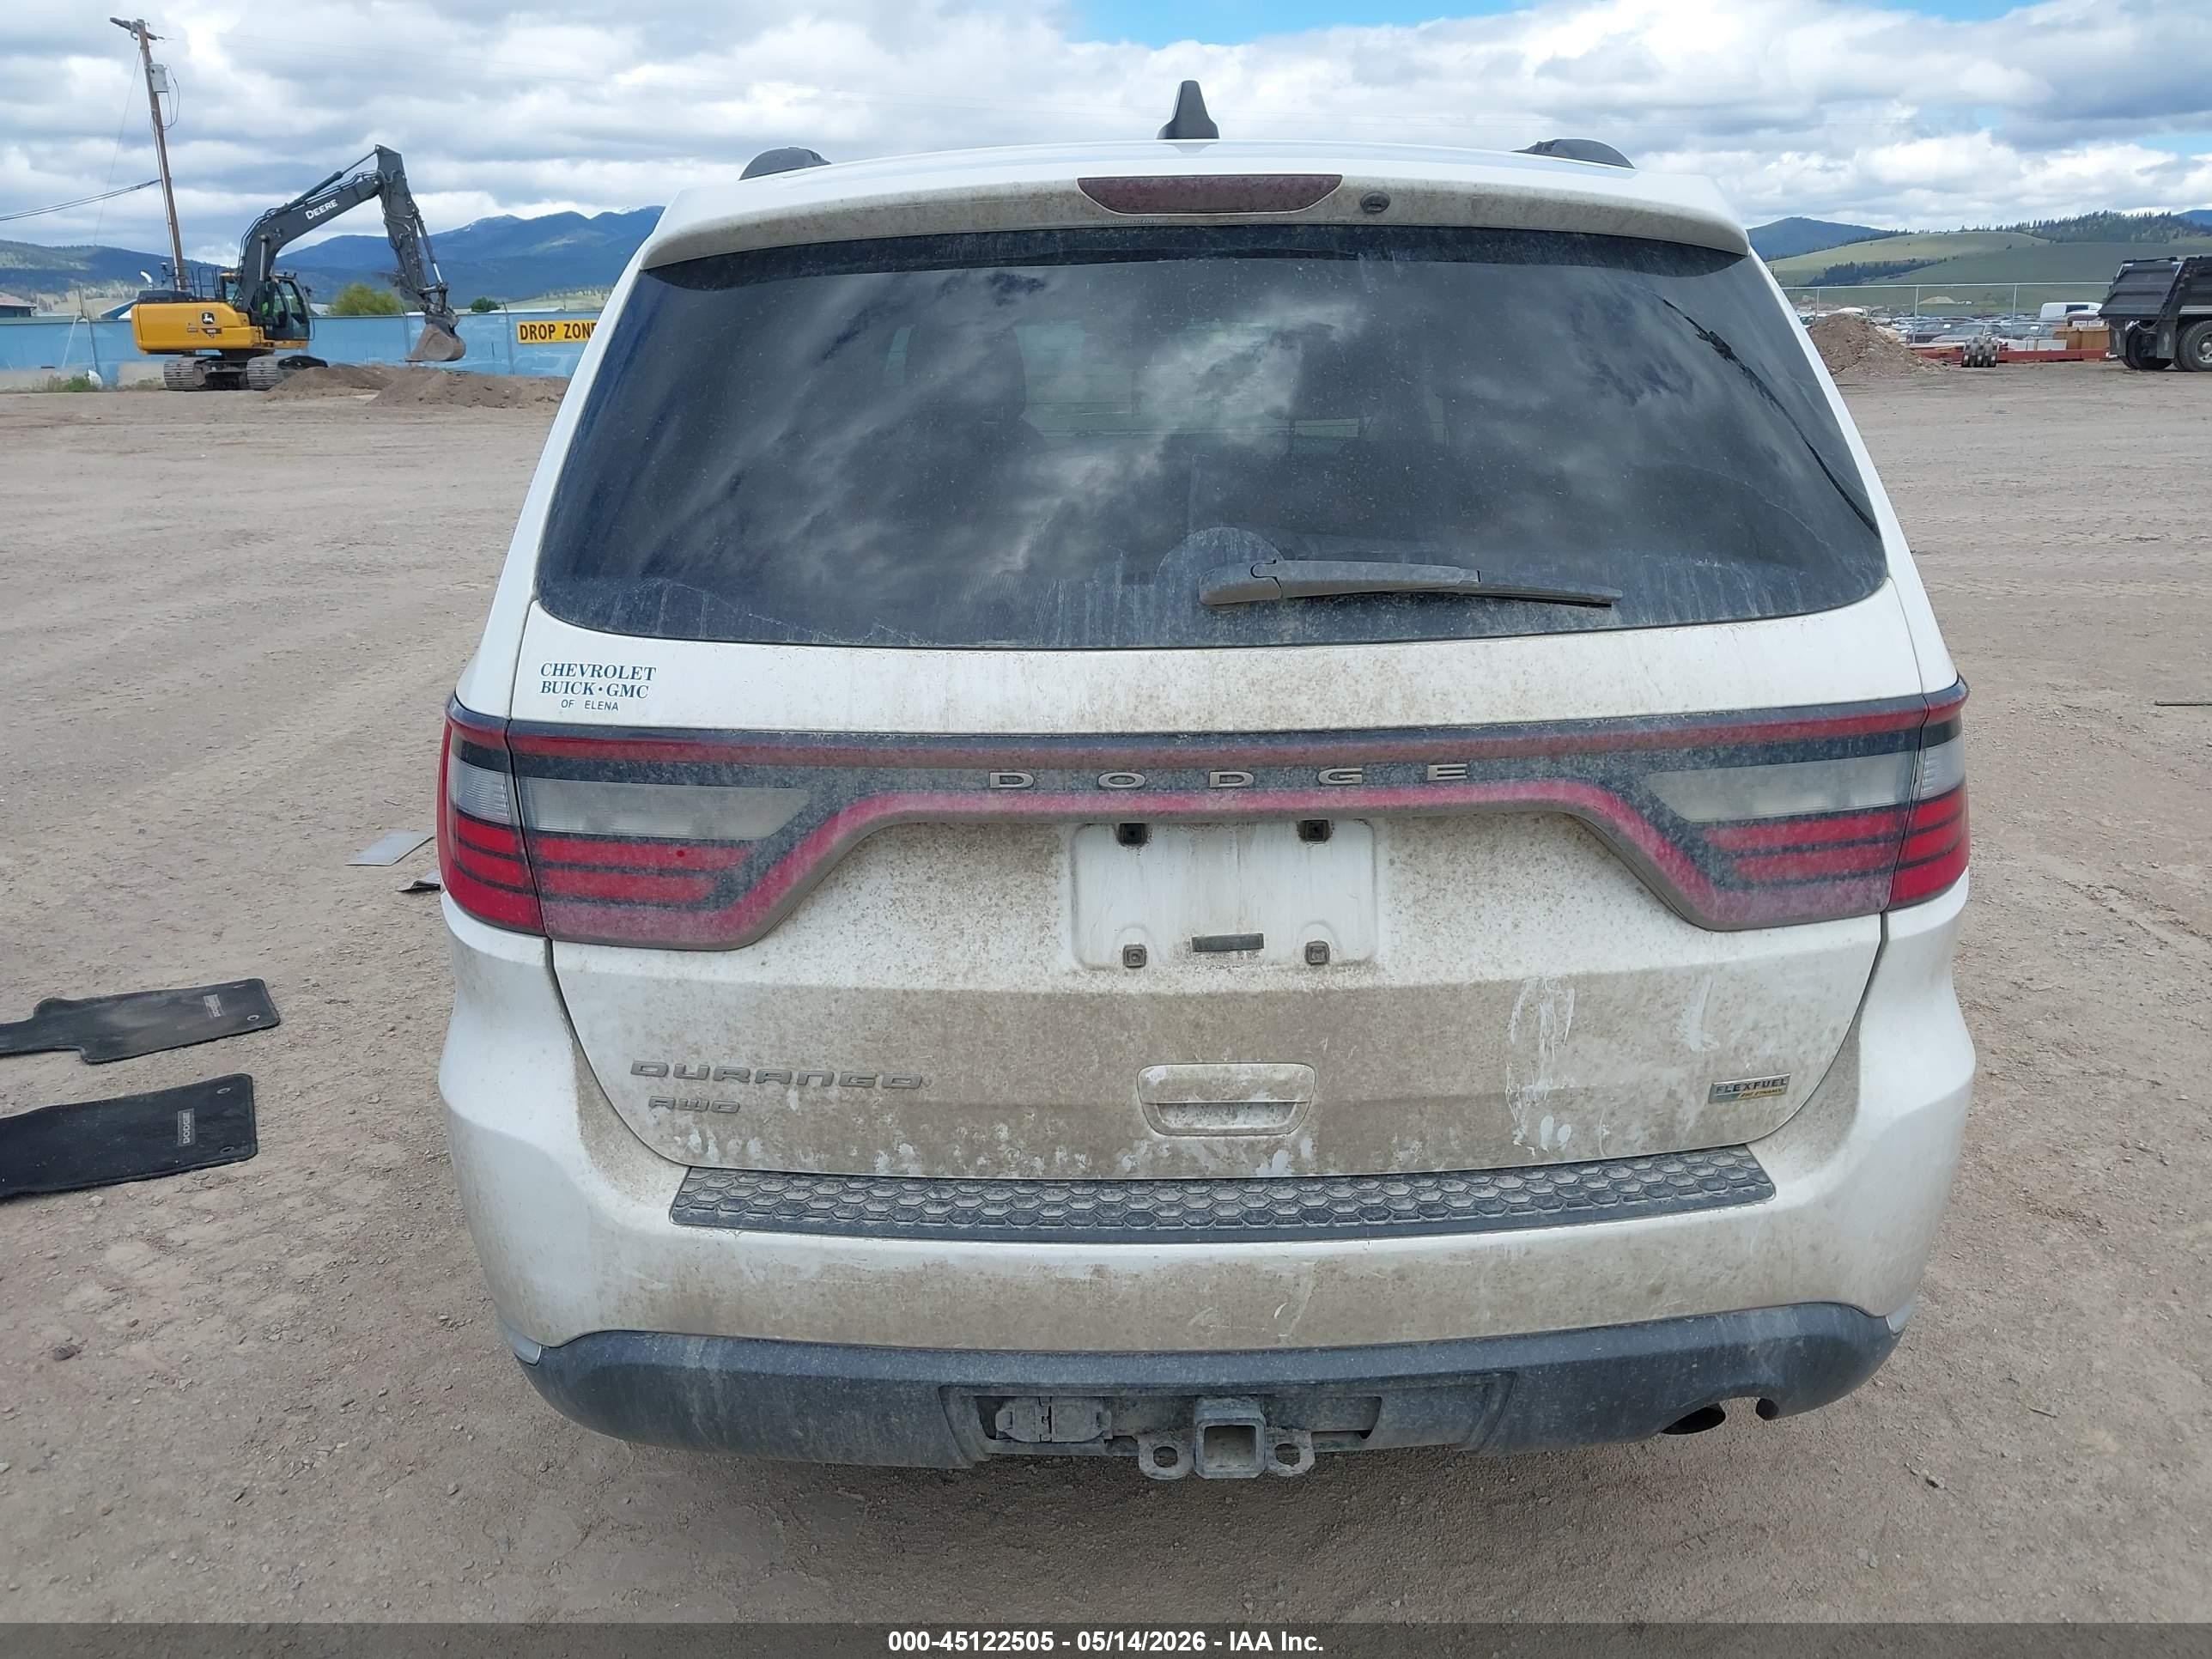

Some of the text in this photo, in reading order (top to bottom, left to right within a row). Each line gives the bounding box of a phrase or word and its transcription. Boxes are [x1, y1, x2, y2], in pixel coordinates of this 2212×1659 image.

[305, 199, 338, 220] DEERE
[520, 324, 556, 340] DROP
[540, 662, 657, 681] CHEVROLET
[561, 699, 619, 711] OF ELENA
[989, 763, 1468, 789] DODGE
[630, 1060, 923, 1089] DURANGO
[1716, 1078, 1788, 1093] FLEXFUEL
[648, 1095, 741, 1114] AWD
